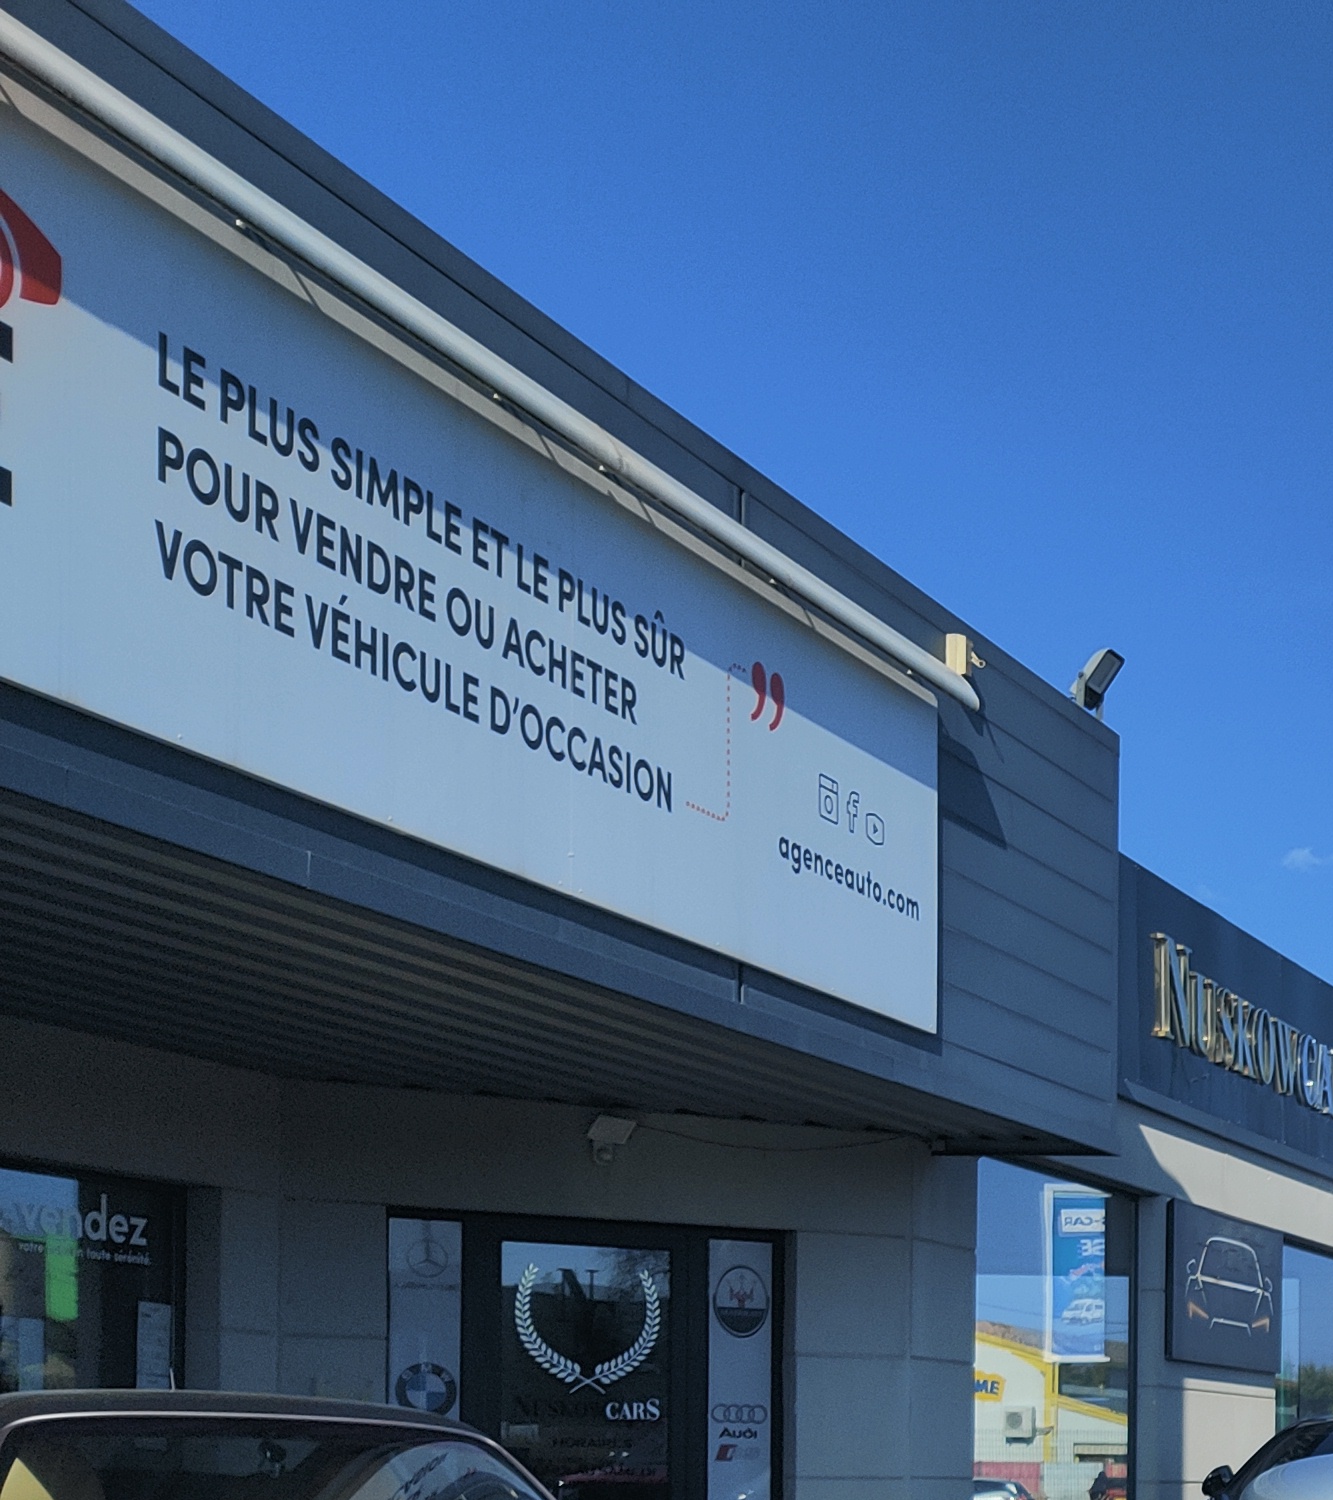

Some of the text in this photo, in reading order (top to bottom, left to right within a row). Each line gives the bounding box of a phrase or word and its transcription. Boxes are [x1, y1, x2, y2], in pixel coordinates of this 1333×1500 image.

[158, 332, 686, 680] LE PLUS SIMPLE ET LE PLUS SÛR
[158, 427, 638, 725] POUR VENDRE OU ACHETER
[155, 519, 672, 812] VOTRE VÉHICULE D'OCCASION
[778, 835, 920, 922] agenceauto.com
[605, 1398, 660, 1421] CARS
